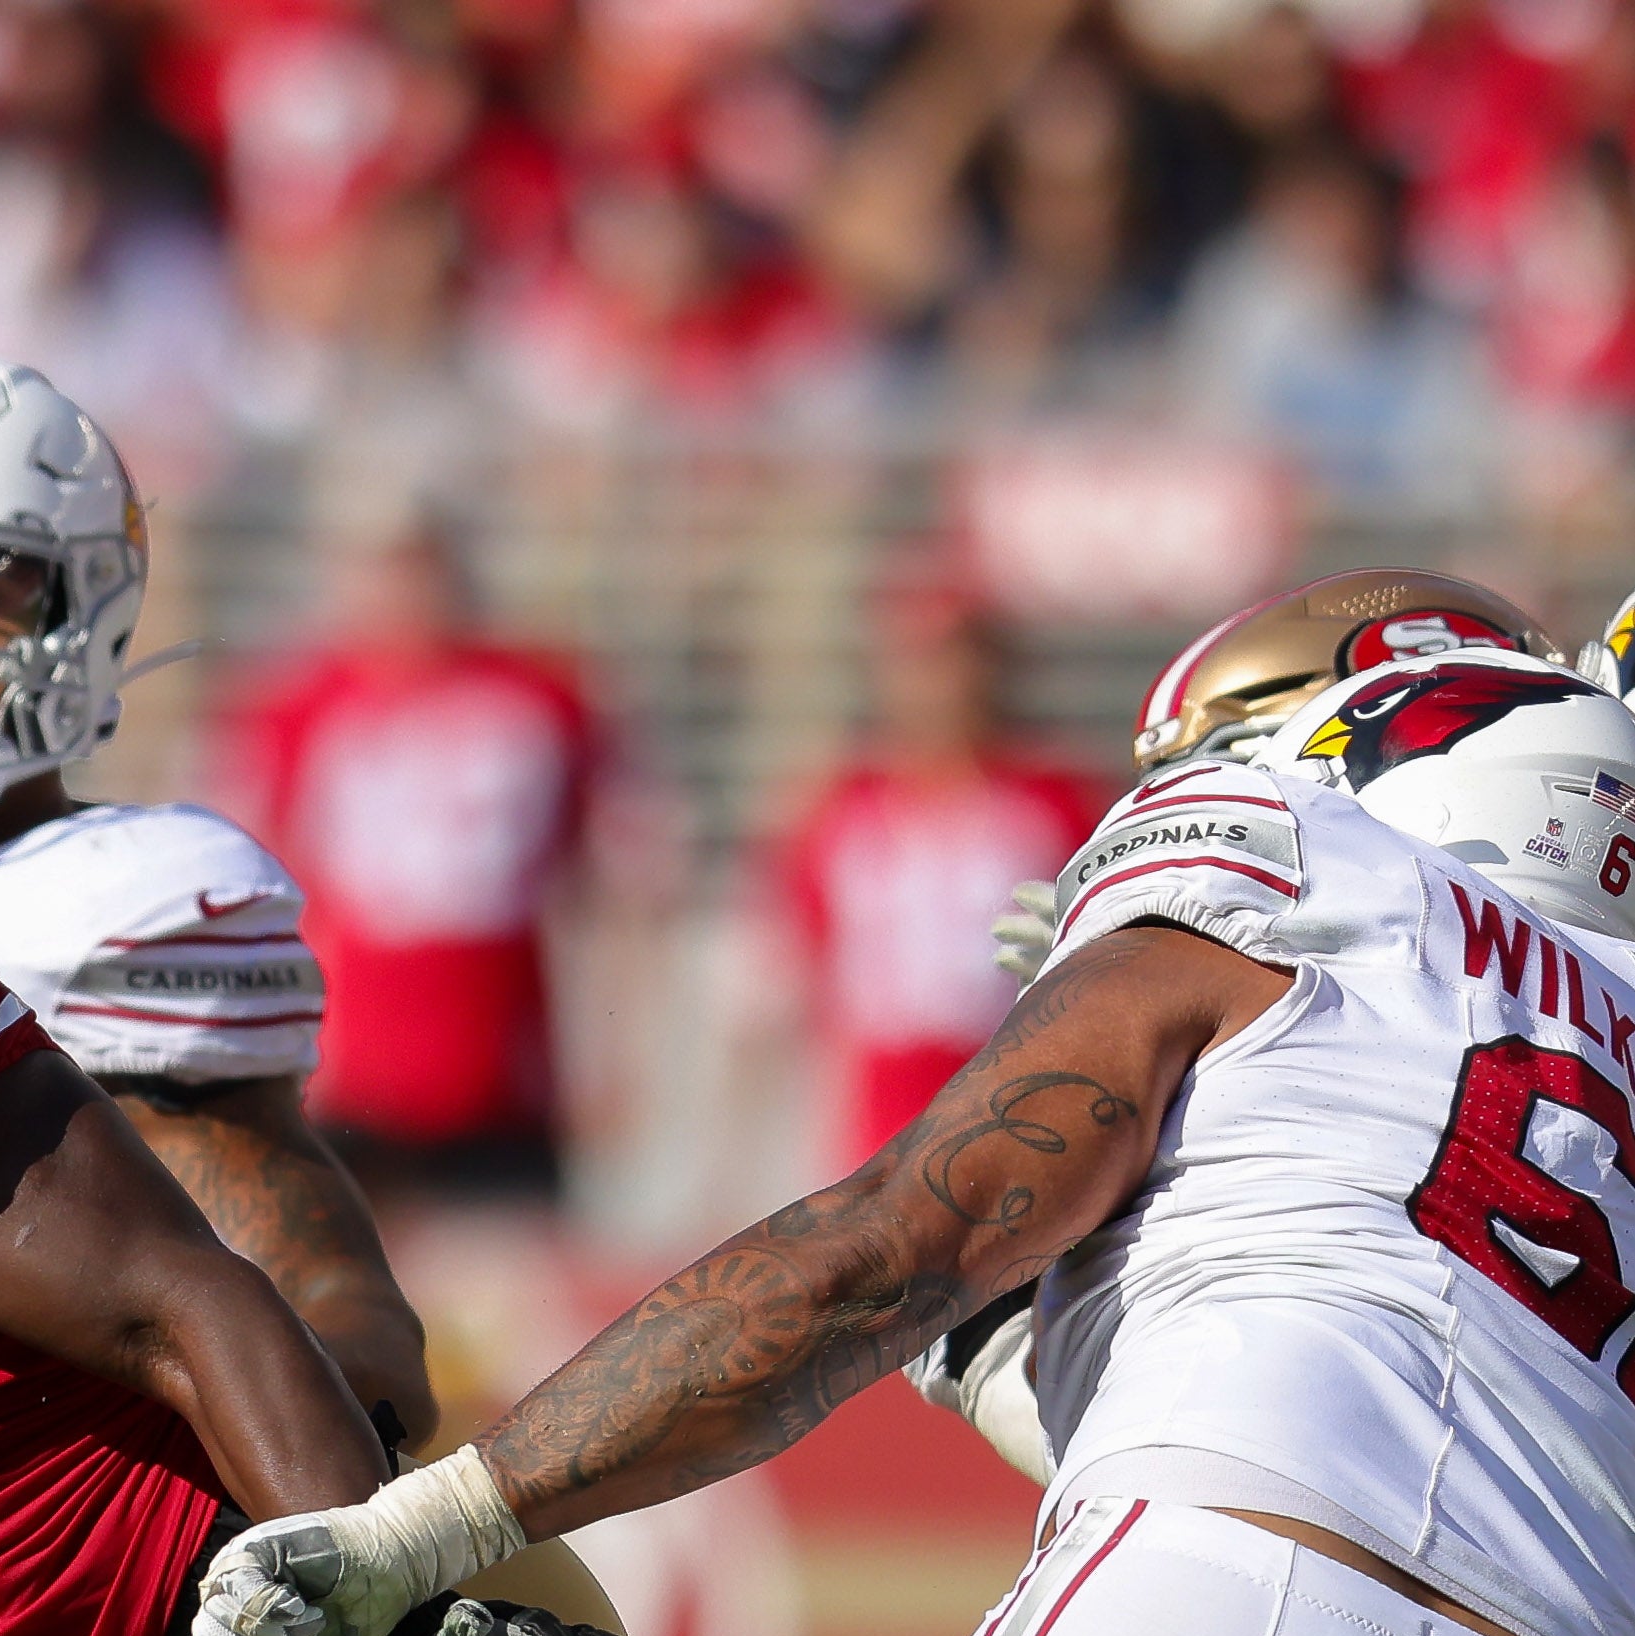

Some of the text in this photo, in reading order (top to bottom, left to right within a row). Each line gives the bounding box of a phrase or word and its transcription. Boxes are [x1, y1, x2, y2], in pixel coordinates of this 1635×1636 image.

[1078, 822, 1248, 884] CARDINALS
[1525, 839, 1570, 863] CATCH
[1404, 1034, 1635, 1363] 6
